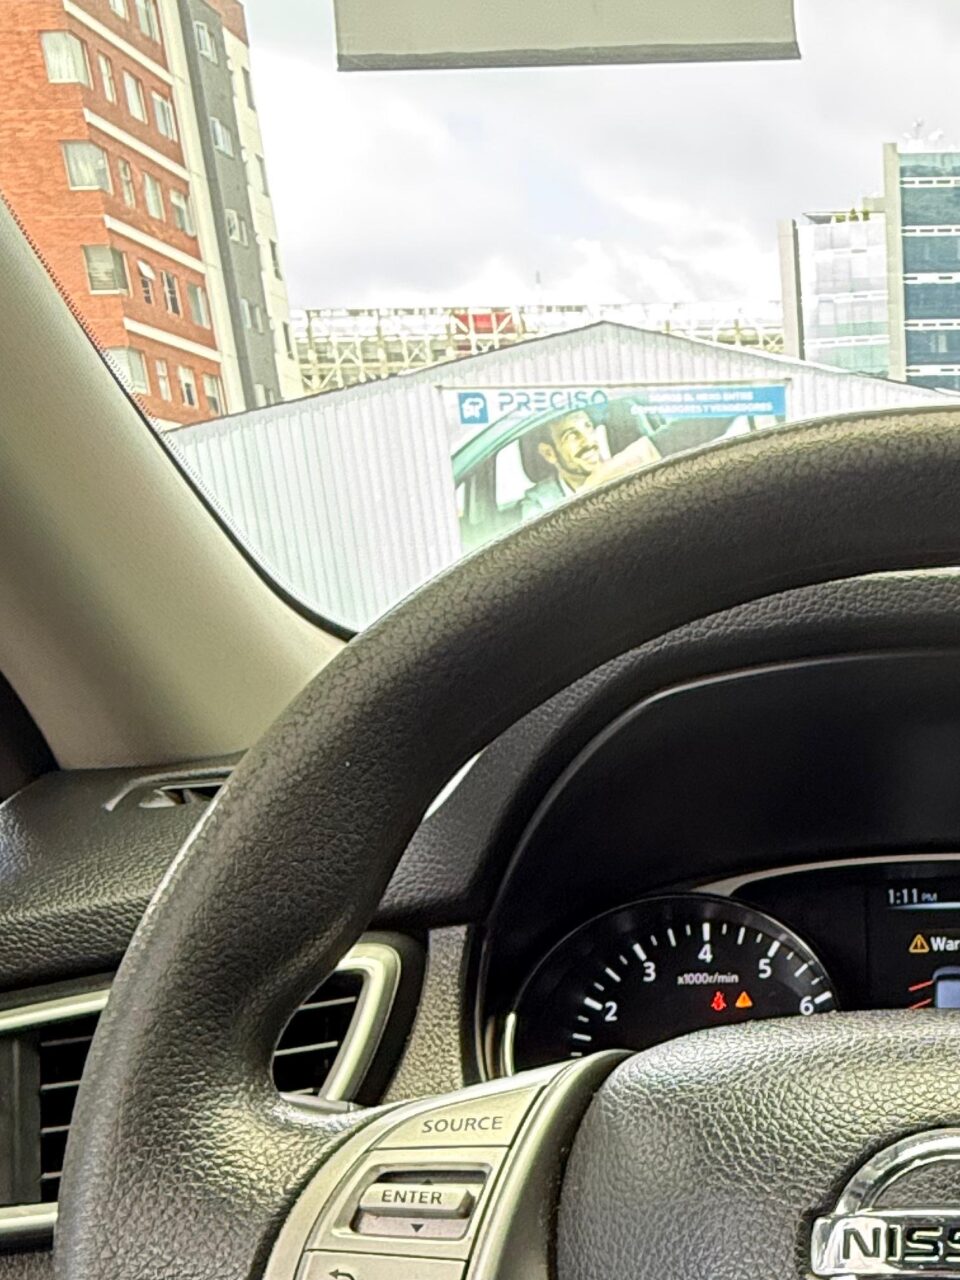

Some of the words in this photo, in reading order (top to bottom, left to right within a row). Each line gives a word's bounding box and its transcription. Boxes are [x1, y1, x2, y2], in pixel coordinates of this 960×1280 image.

[498, 390, 609, 411] PRECISO
[888, 888, 918, 904] 1:11
[698, 945, 713, 963] 4
[643, 962, 656, 982] 3
[758, 959, 771, 979] 5
[604, 1001, 618, 1022] 2
[800, 996, 814, 1016] 6
[422, 1115, 504, 1134] SOURCE
[381, 1188, 443, 1206] ENTER
